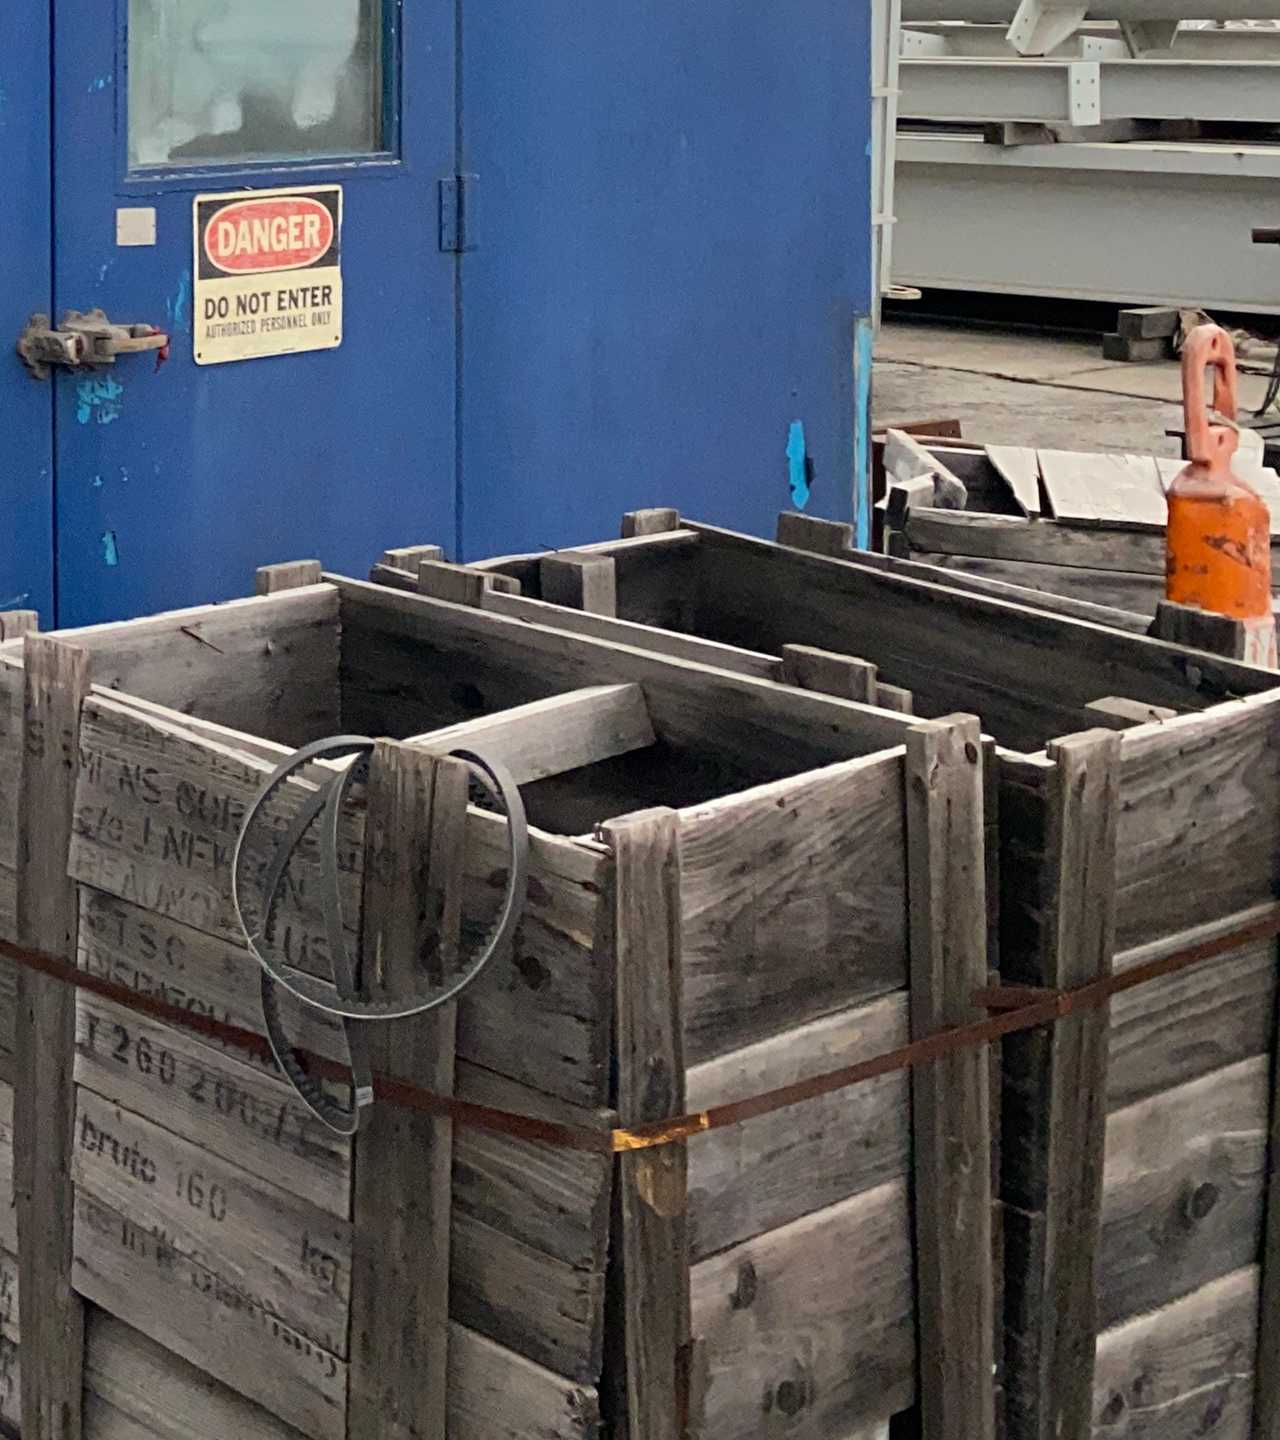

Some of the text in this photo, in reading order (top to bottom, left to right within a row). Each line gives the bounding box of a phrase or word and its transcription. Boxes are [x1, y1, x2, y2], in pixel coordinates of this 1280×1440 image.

[217, 213, 322, 257] DANGER
[204, 285, 333, 320] DO NOT ENTER
[206, 310, 331, 338] AUTHORIZED PERSONNEL ONLY
